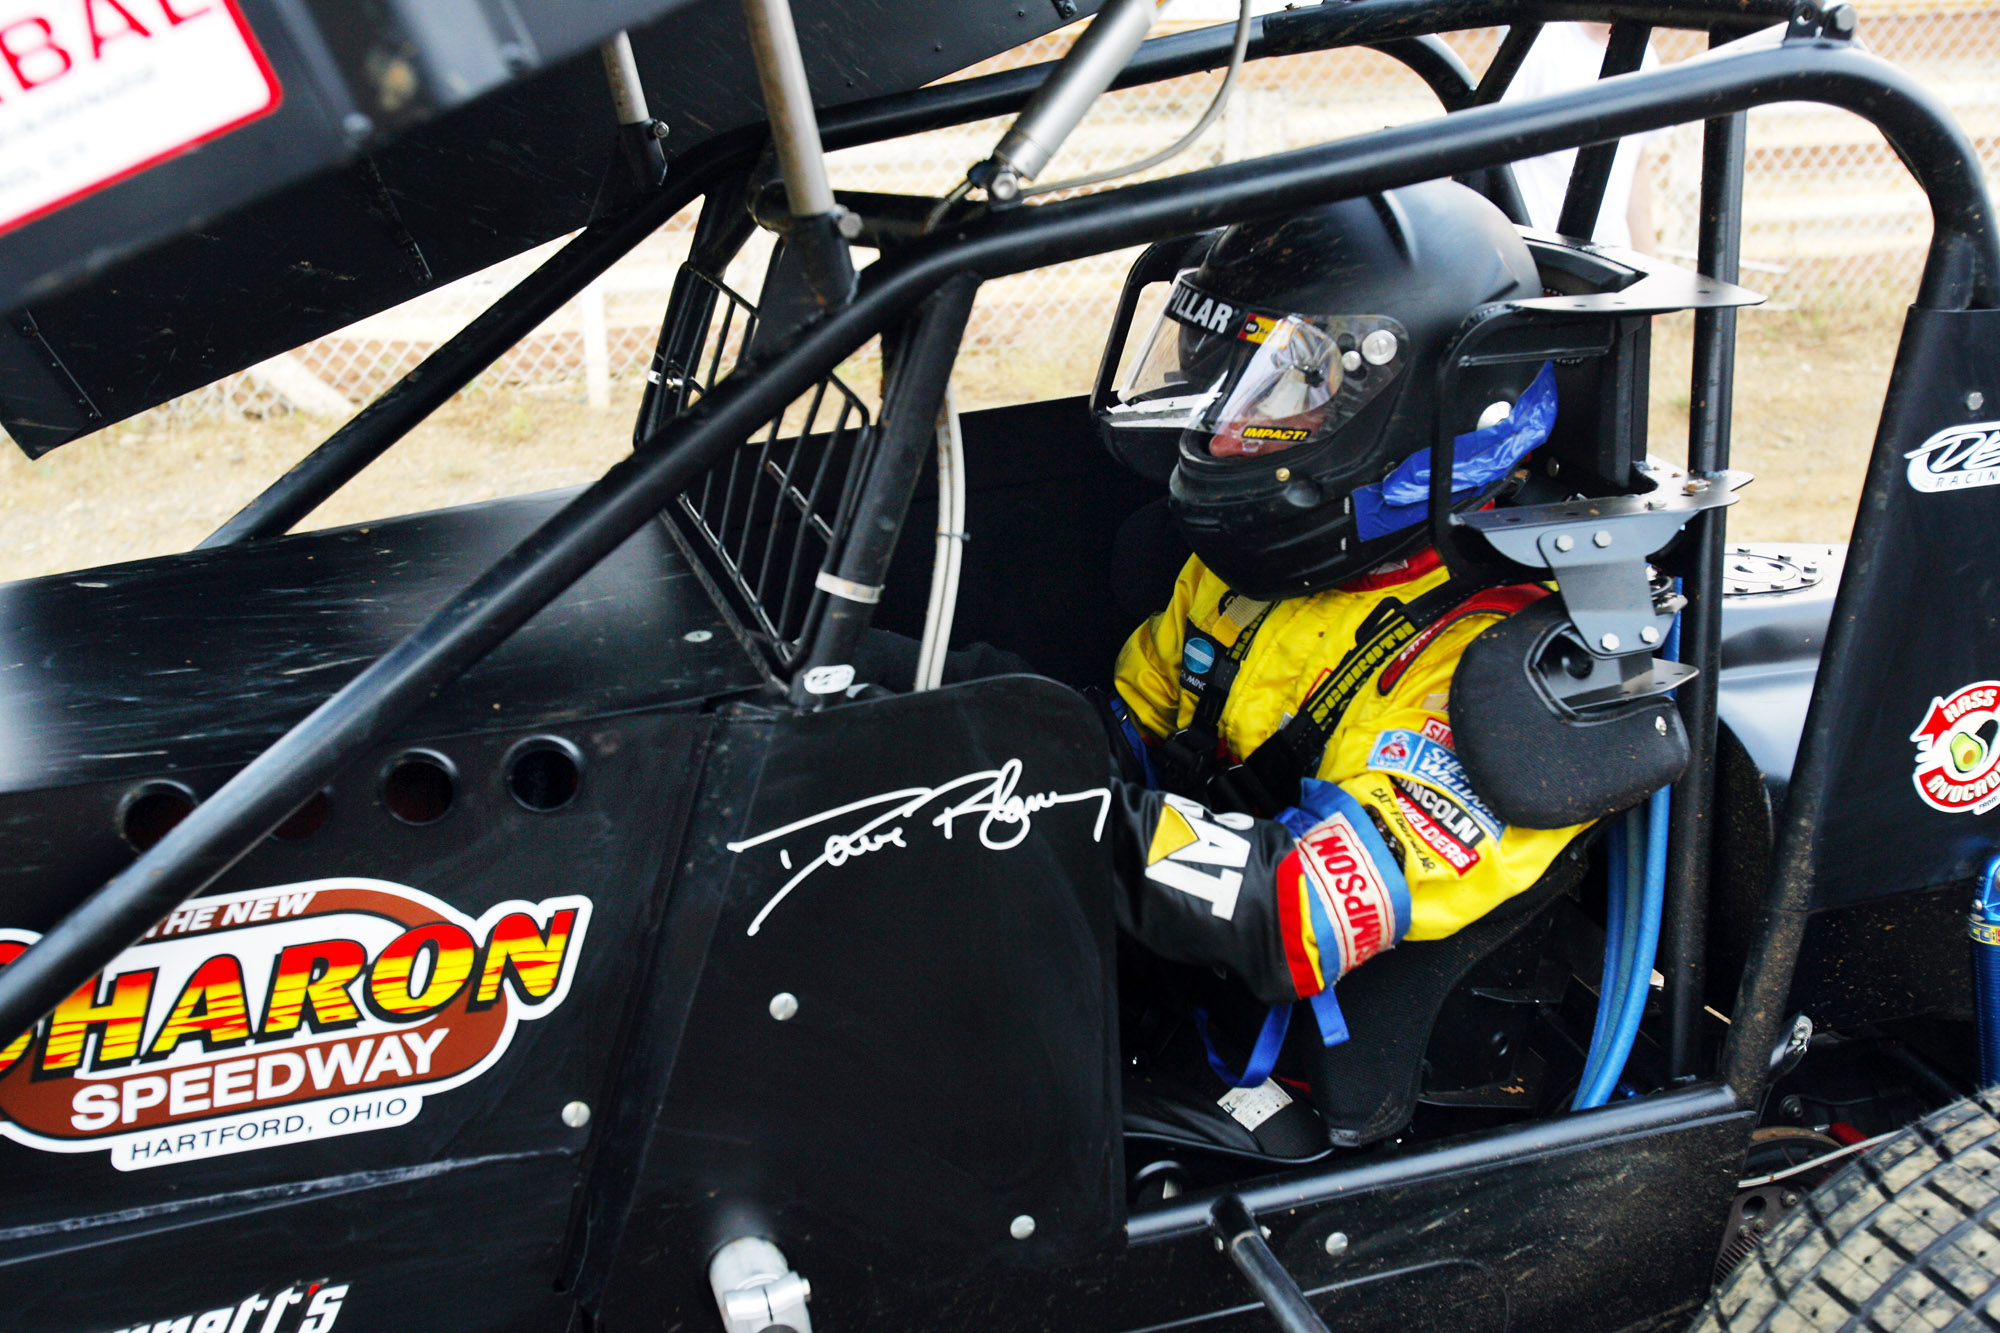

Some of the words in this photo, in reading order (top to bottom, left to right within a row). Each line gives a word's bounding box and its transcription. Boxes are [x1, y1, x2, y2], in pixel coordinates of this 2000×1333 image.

[1243, 426, 1308, 441] IMPACT!
[1311, 620, 1417, 724] SCHROTH
[1942, 688, 1998, 723] HASS
[1396, 796, 1472, 869] WELDERS
[220, 891, 318, 927] NEW
[1300, 831, 1381, 973] SIMPSON
[70, 1027, 450, 1132] SPEEDWAY
[131, 1114, 314, 1162] HARTFORD,
[328, 1097, 408, 1126] OHIO
